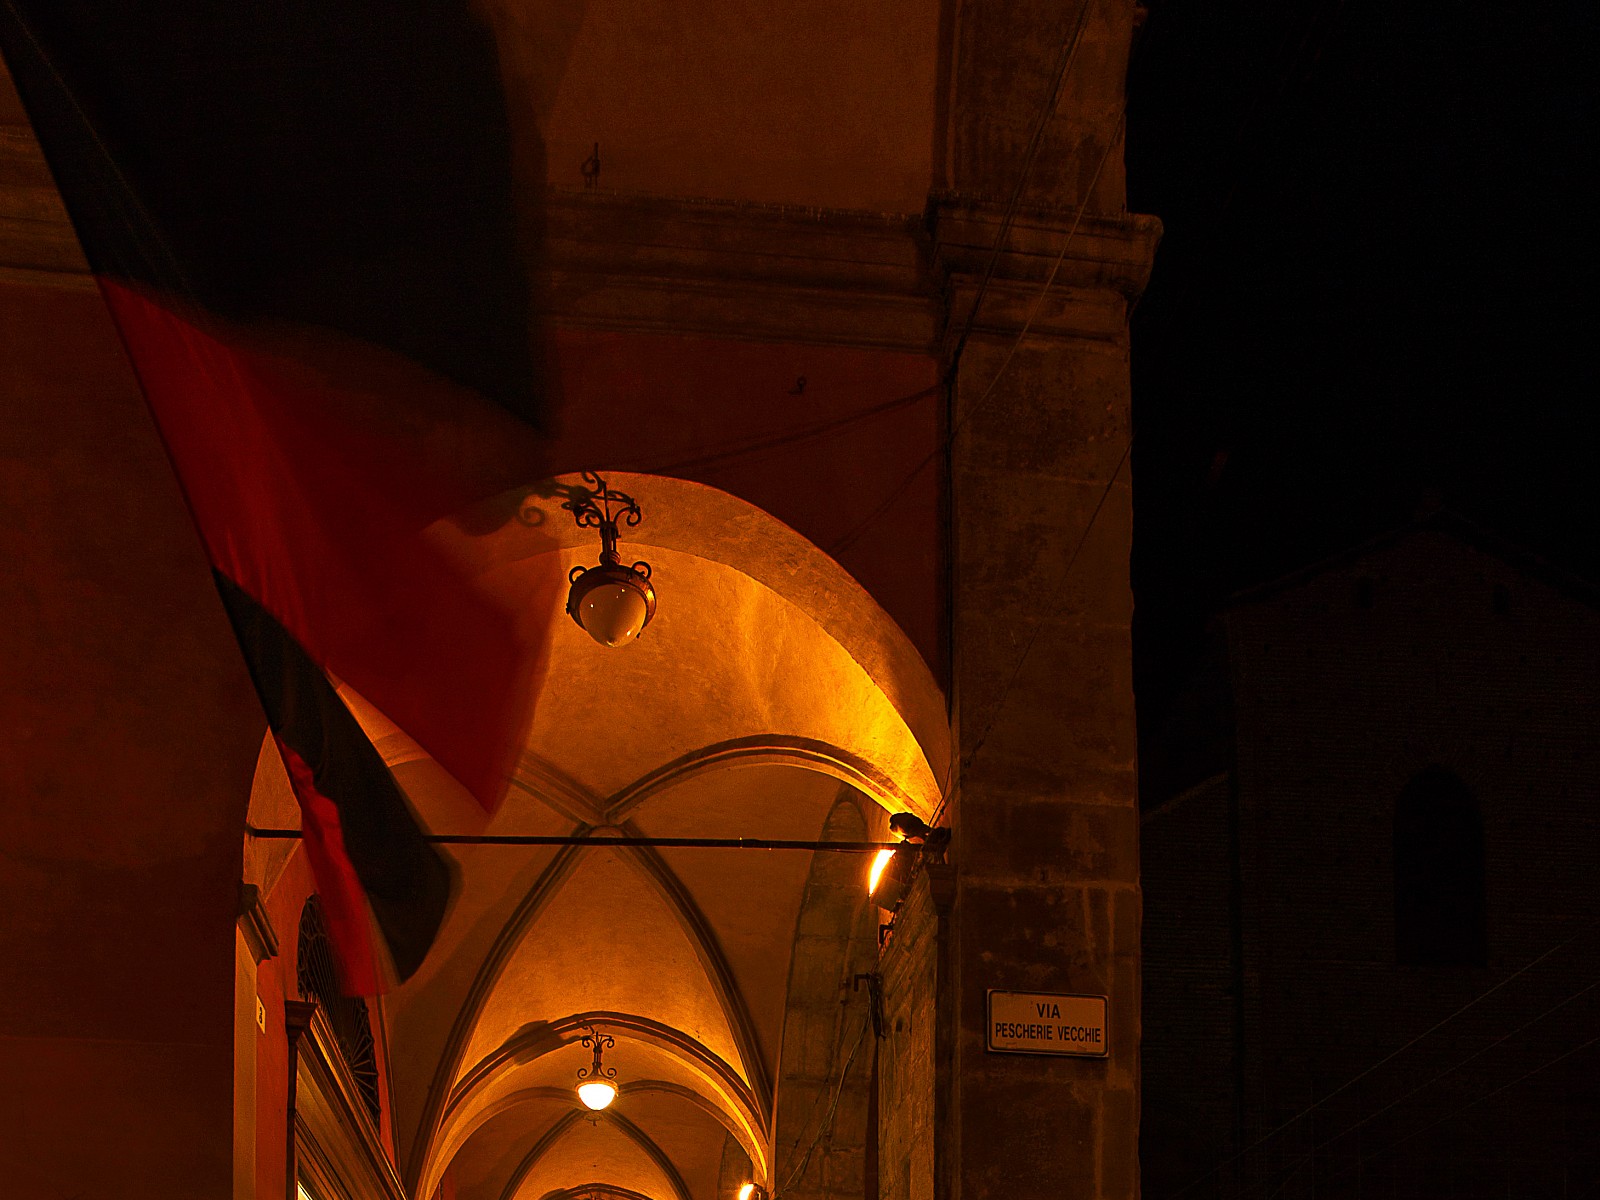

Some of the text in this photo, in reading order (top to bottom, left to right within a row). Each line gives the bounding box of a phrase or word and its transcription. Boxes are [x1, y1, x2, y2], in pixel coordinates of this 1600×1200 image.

[1036, 1003, 1061, 1019] VIA
[995, 1022, 1101, 1043] PESCHERIE VECCHIE
